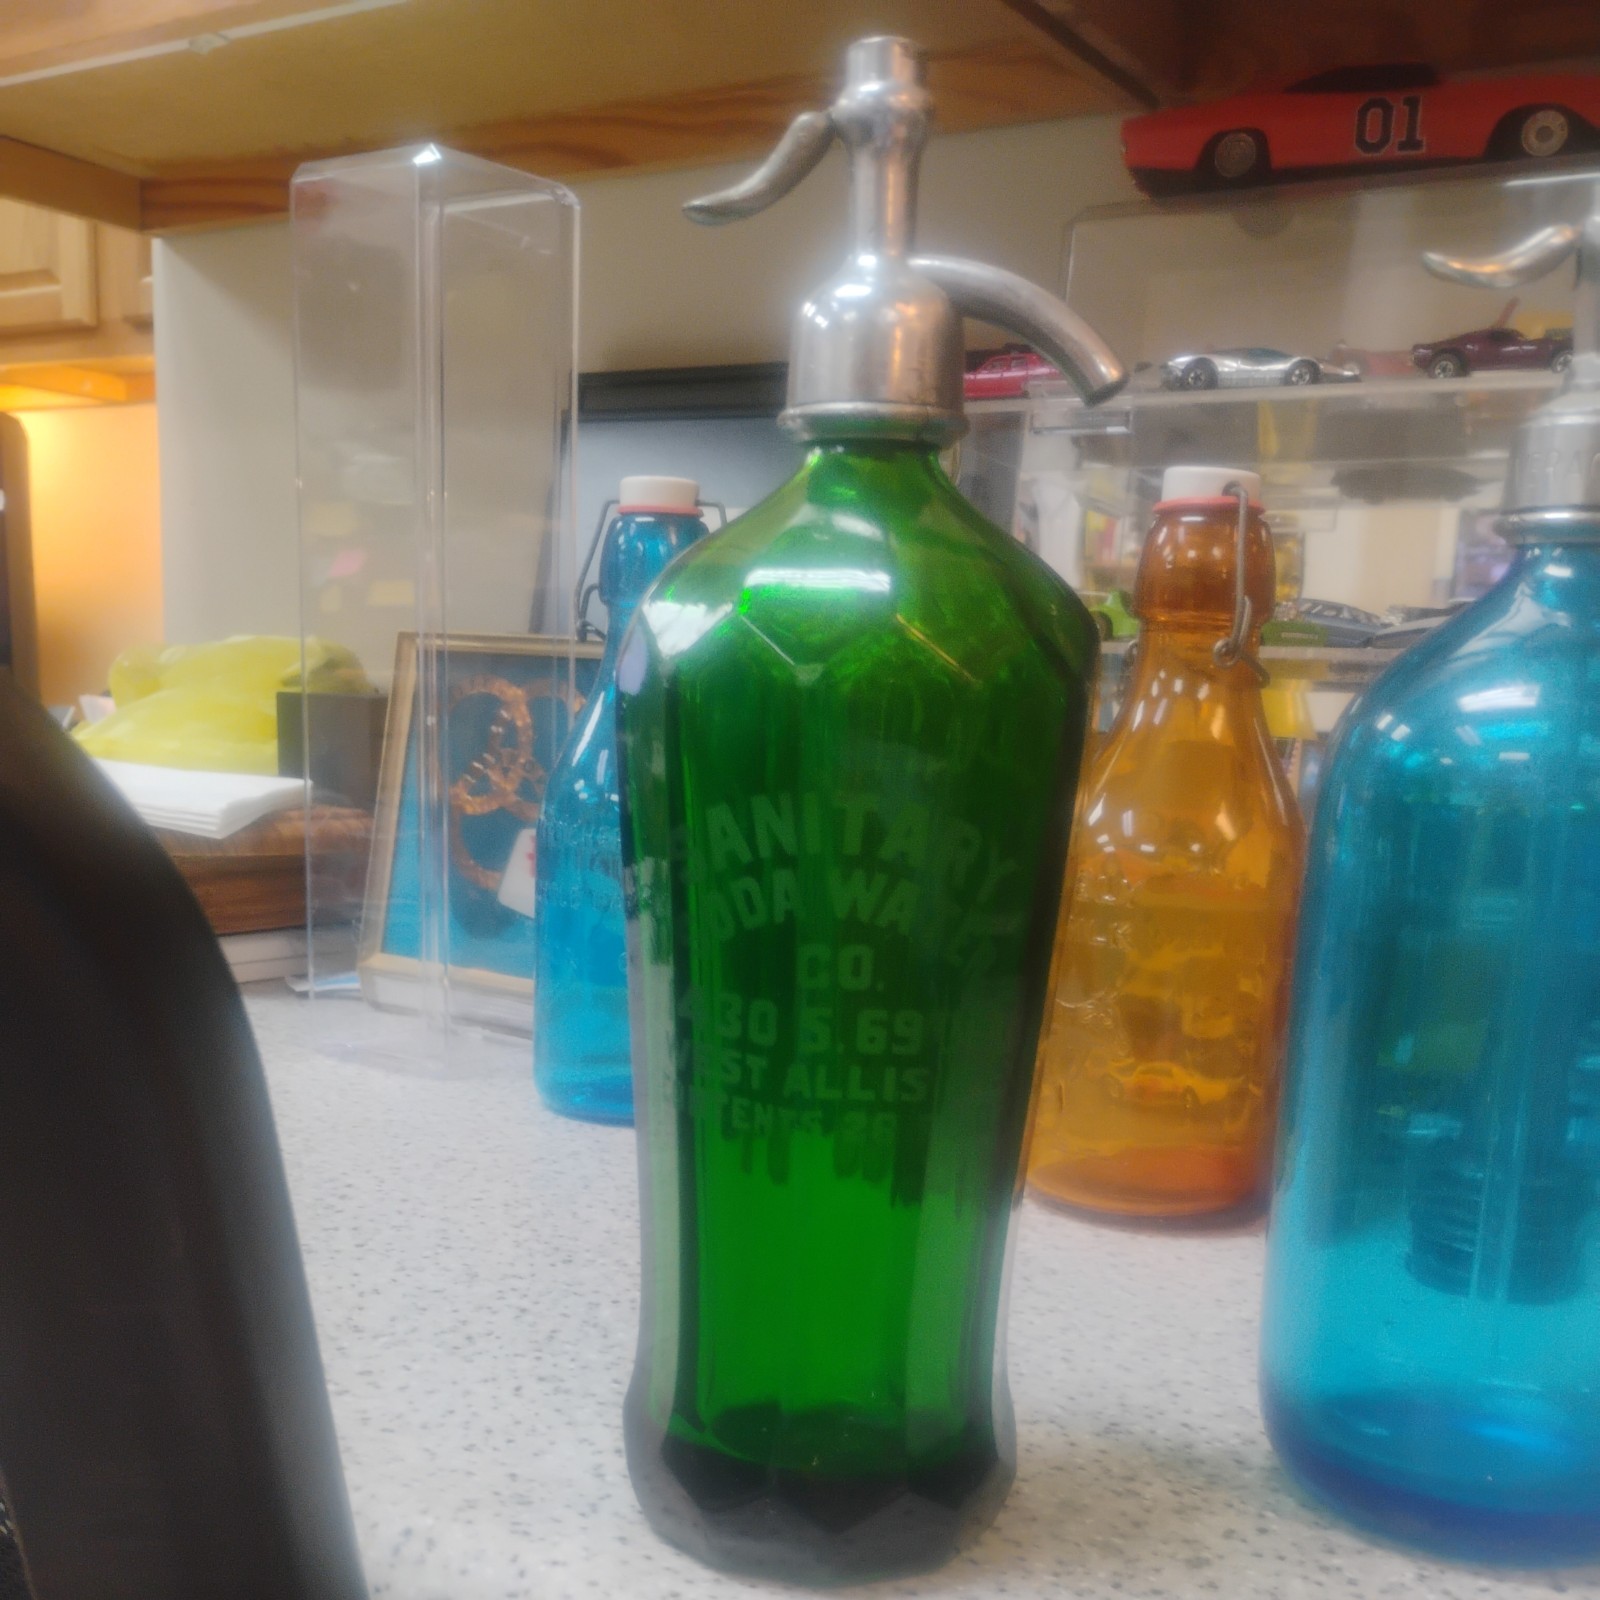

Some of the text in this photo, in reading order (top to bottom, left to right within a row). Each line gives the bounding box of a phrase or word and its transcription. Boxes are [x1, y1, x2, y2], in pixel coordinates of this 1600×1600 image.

[1355, 95, 1425, 155] 01
[698, 868, 803, 941] ODA
[798, 942, 885, 992] CO.
[783, 1062, 930, 1102] ALLIS
